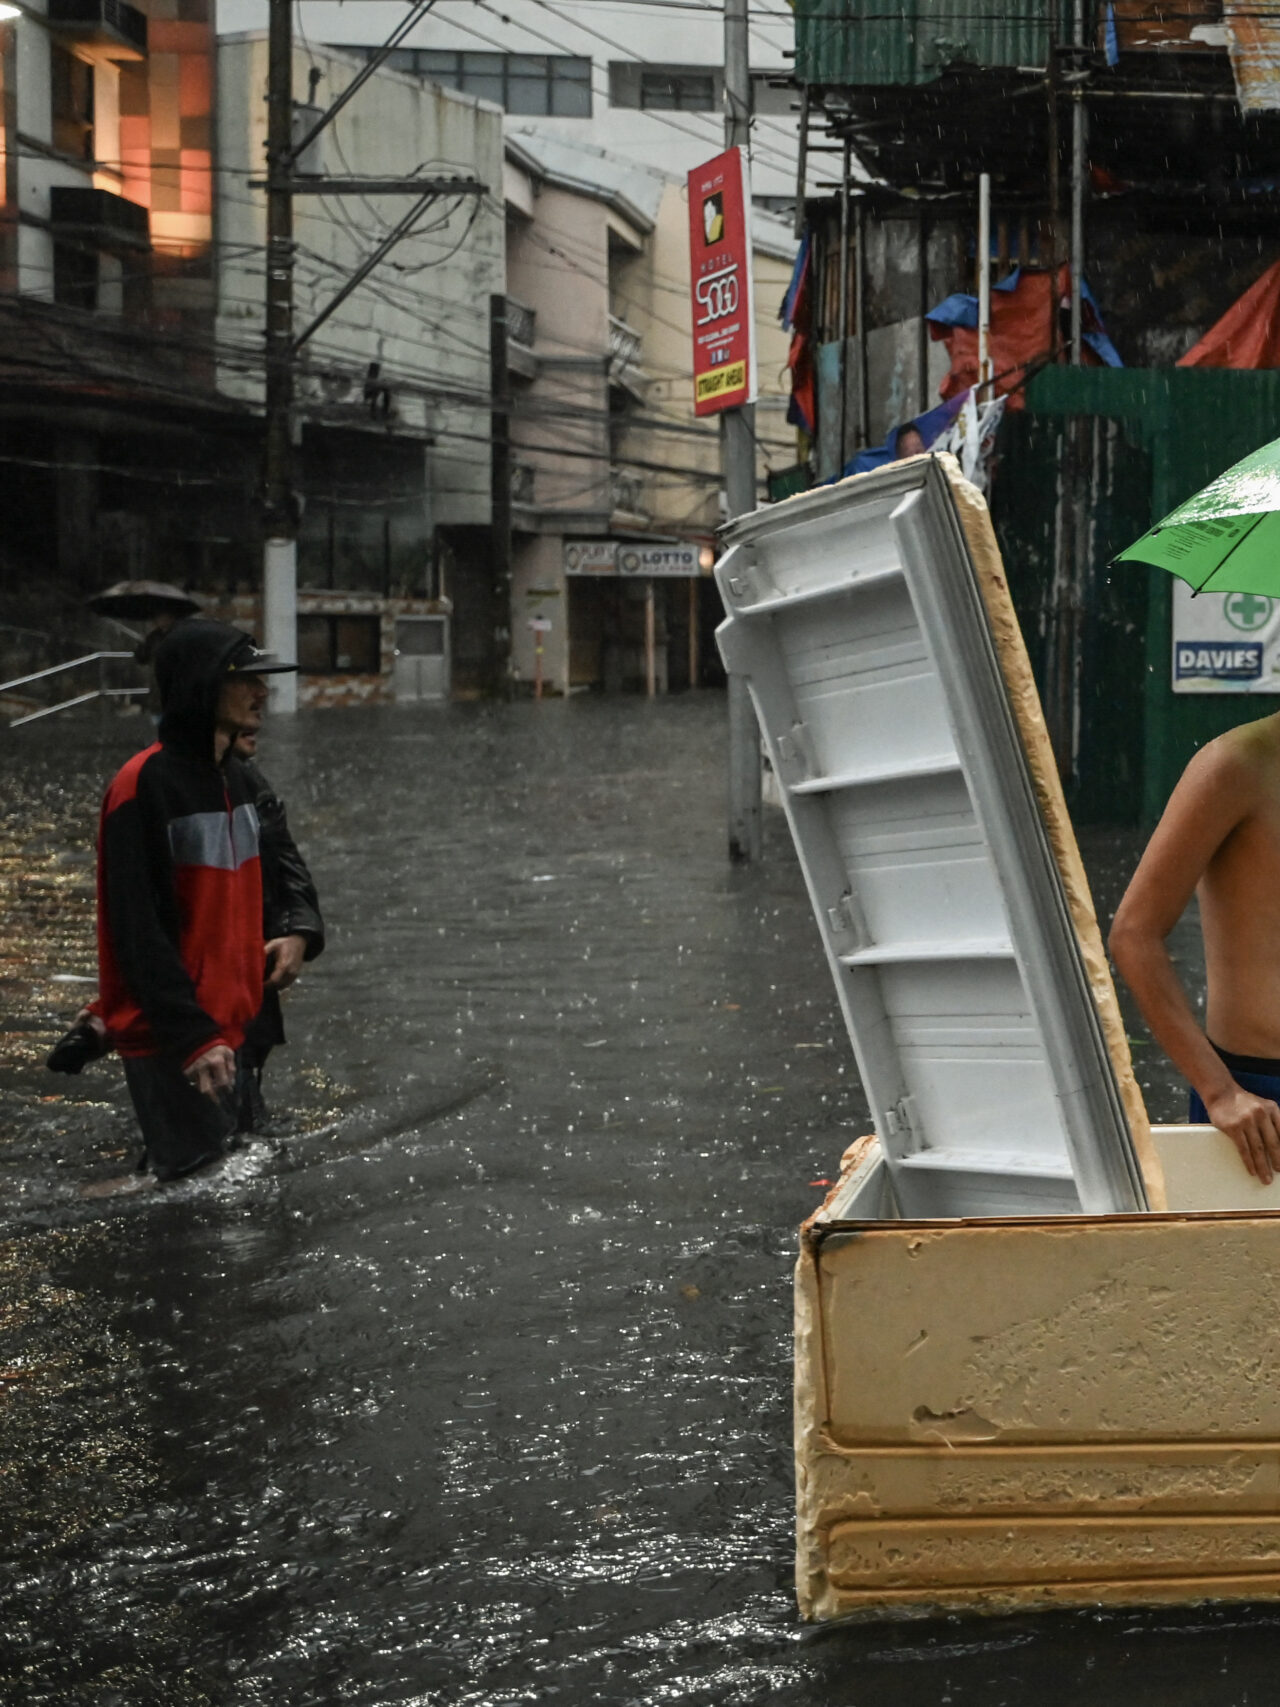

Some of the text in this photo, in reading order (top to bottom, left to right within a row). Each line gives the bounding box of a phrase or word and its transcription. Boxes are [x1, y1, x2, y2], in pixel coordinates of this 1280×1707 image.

[700, 253, 733, 274] HOTEL
[696, 263, 739, 326] SOGO
[643, 552, 693, 564] LOTTO
[1179, 650, 1259, 669] DAVIES
